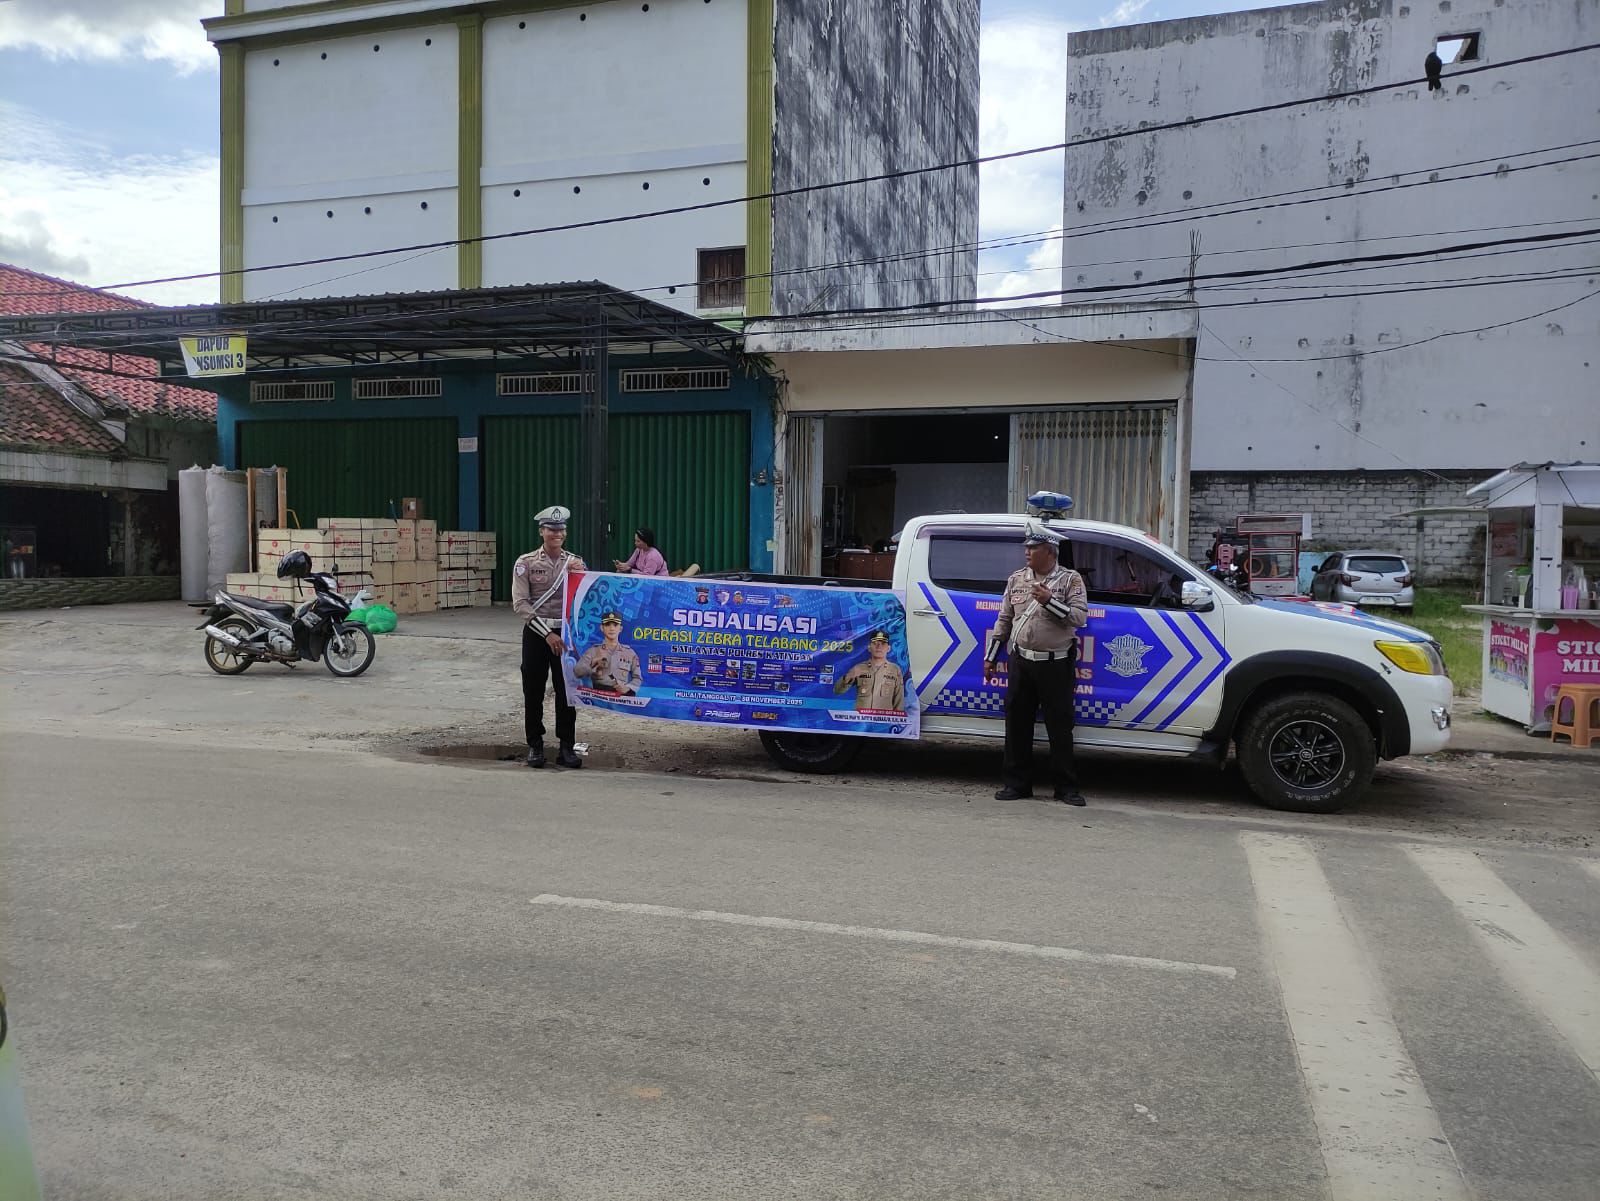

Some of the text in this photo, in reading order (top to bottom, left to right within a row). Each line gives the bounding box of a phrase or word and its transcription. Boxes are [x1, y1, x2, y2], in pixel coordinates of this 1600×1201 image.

[197, 336, 230, 352] DAPUR
[236, 353, 244, 368] 3
[672, 608, 817, 635] SOSIALISASI
[633, 627, 854, 653] OPERASI ZEBRA TELABANG 2025
[671, 644, 726, 657] SATLANTAS
[728, 648, 764, 659] POLRES
[675, 691, 697, 699] MULAI
[697, 692, 728, 701] TANGGAL
[750, 697, 787, 705] NOVEMBER
